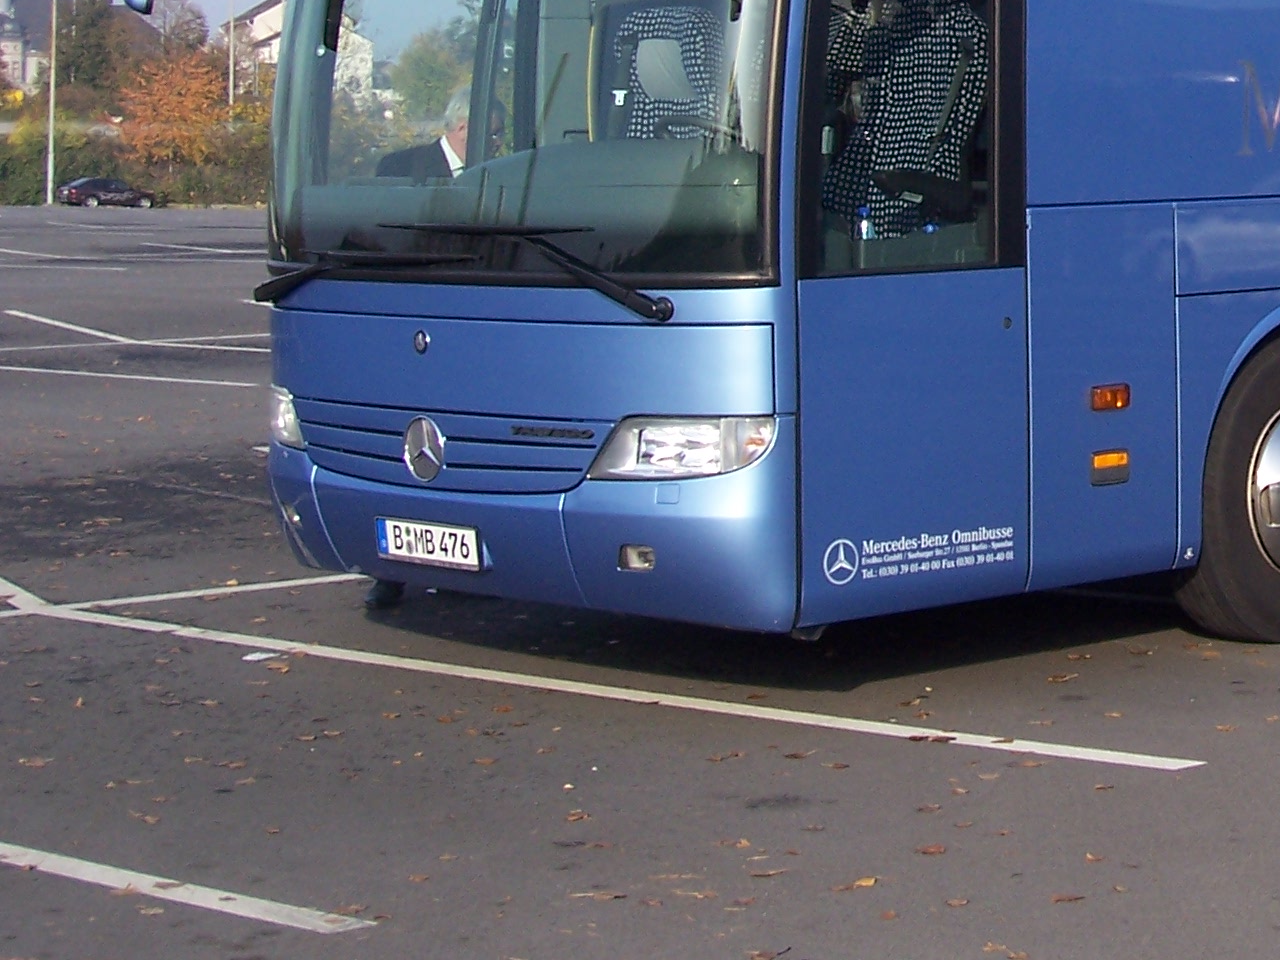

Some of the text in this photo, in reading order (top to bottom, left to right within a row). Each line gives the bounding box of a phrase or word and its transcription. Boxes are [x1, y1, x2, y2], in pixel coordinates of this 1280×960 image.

[393, 524, 470, 559] B MB 476
[862, 533, 949, 555] Mercedes-Benz
[952, 526, 1013, 544] Omnibusse
